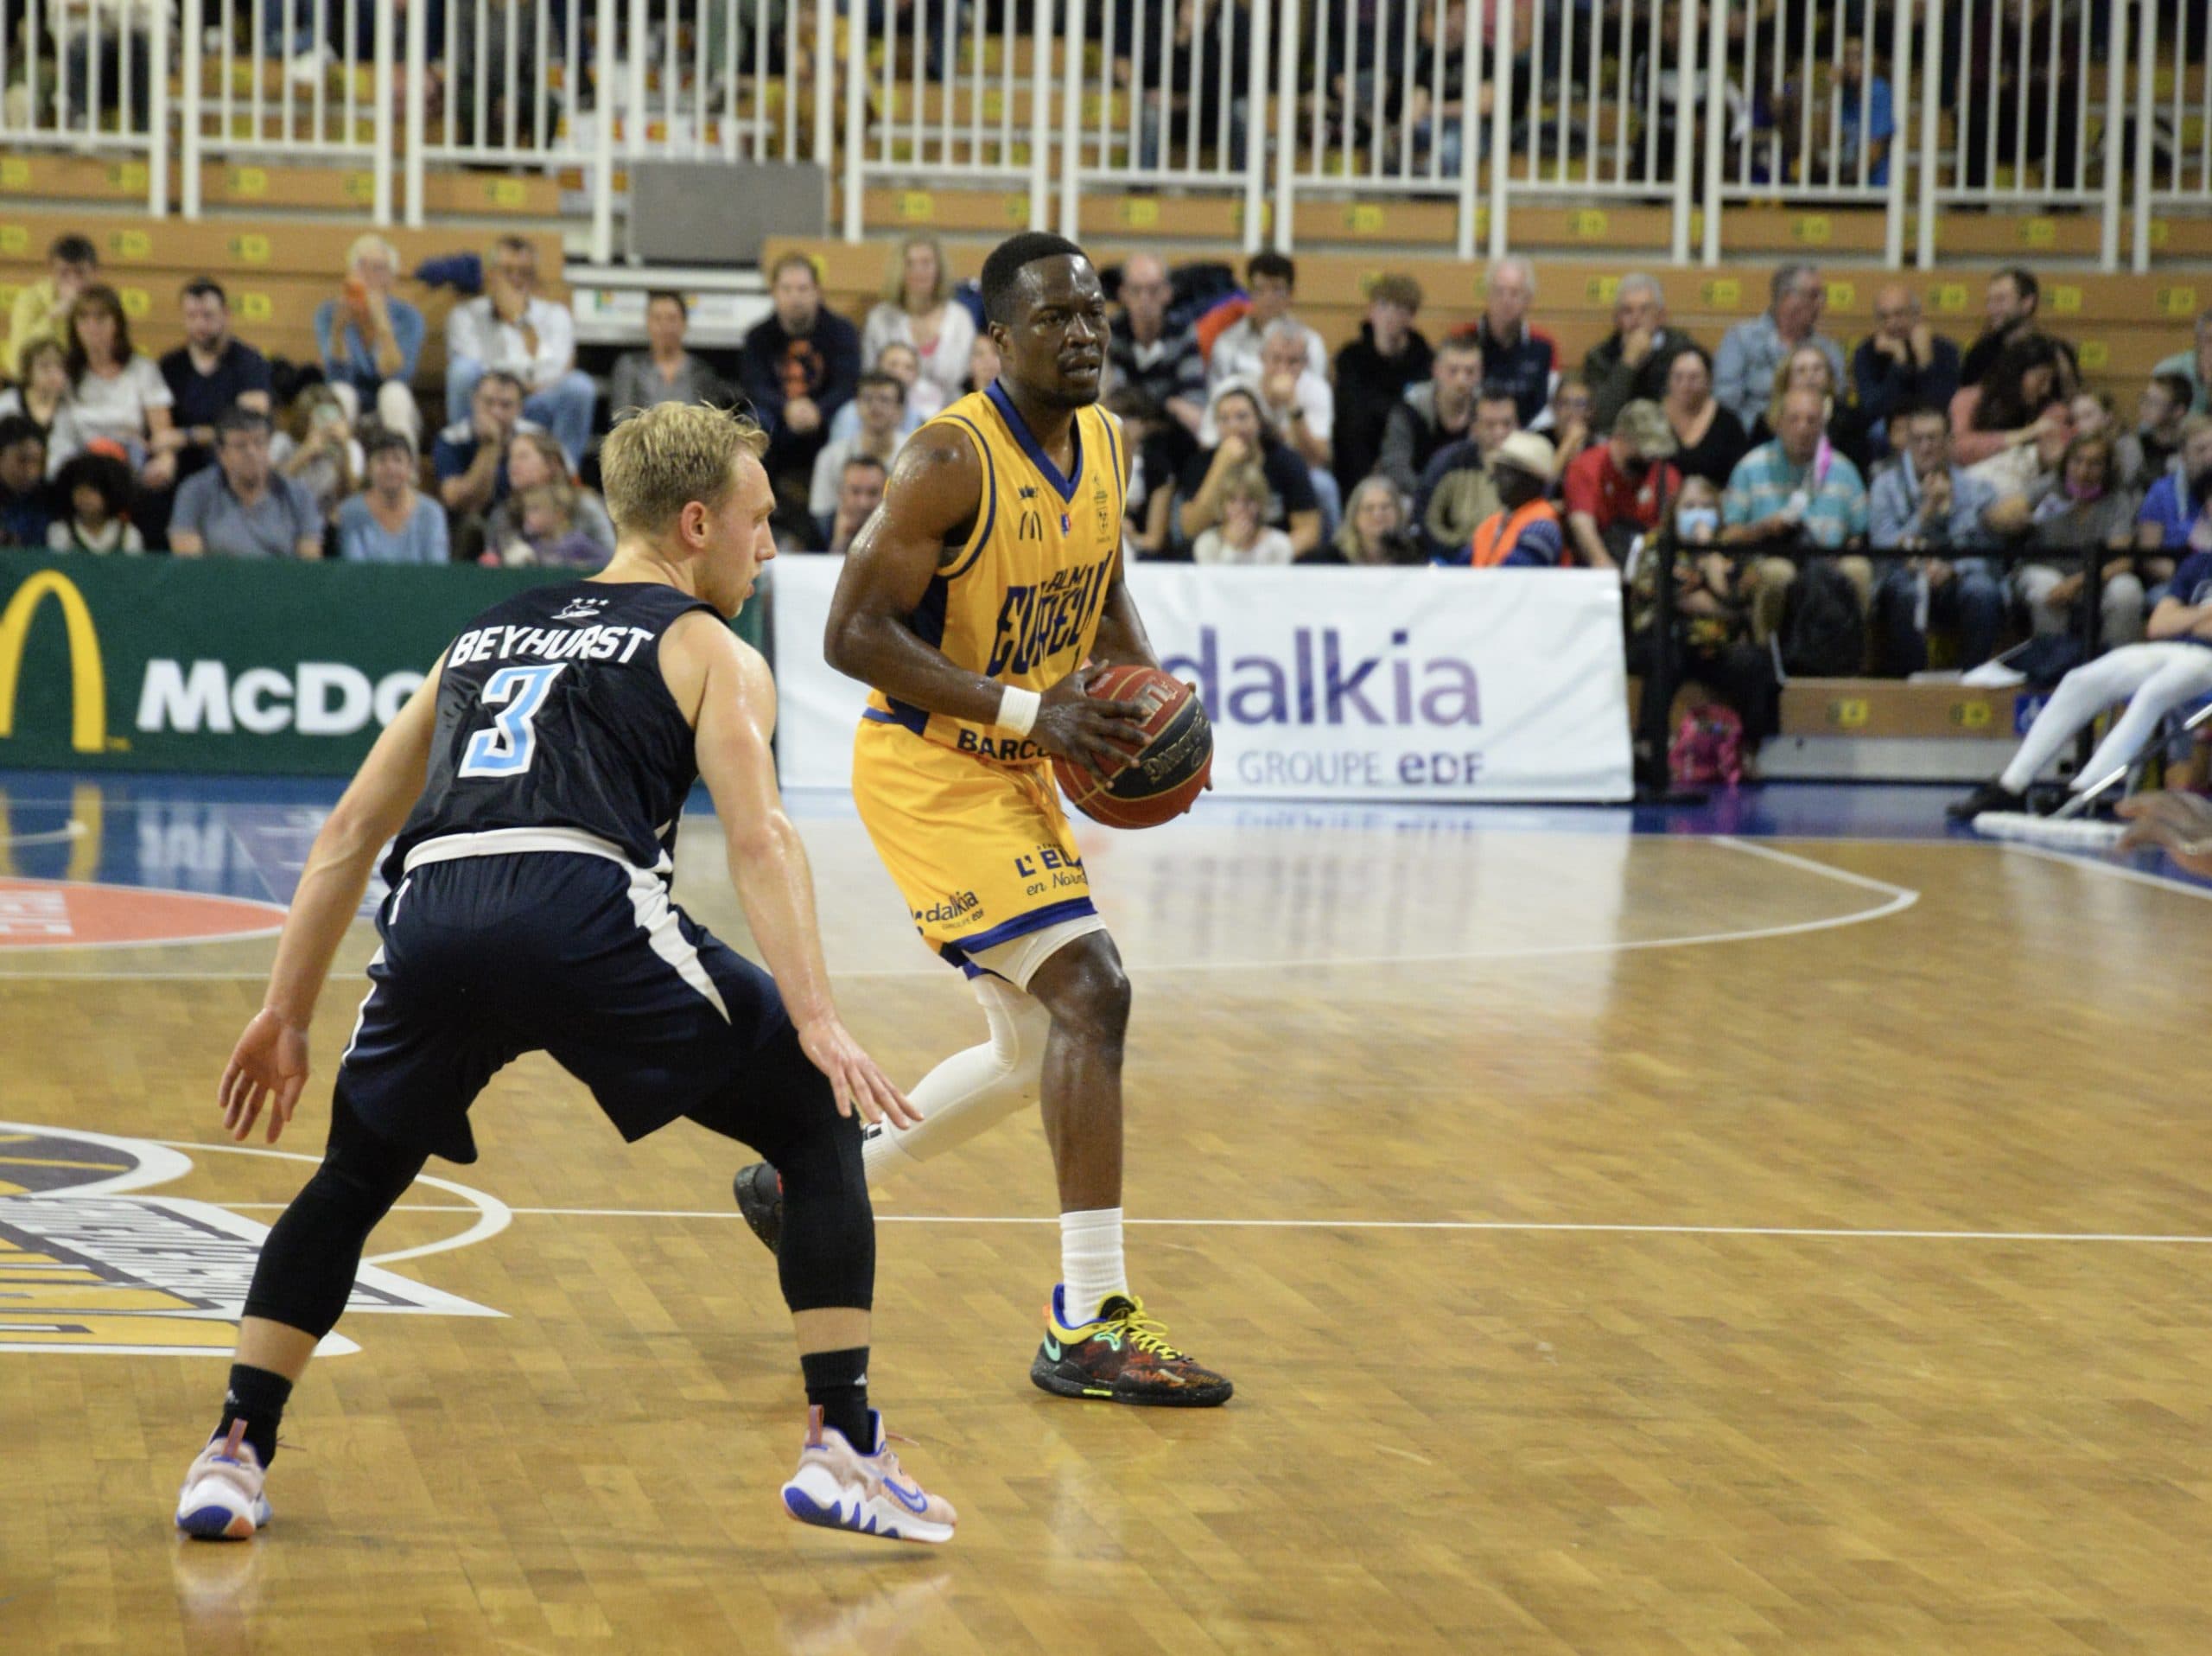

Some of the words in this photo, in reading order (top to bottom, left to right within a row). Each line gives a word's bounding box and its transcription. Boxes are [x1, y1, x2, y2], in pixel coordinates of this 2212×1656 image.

[448, 624, 657, 669] BEYHURST
[1160, 624, 1482, 726] dalkia
[457, 662, 569, 778] 3
[1237, 749, 1382, 786] GROUPE
[925, 889, 980, 924] dalkia
